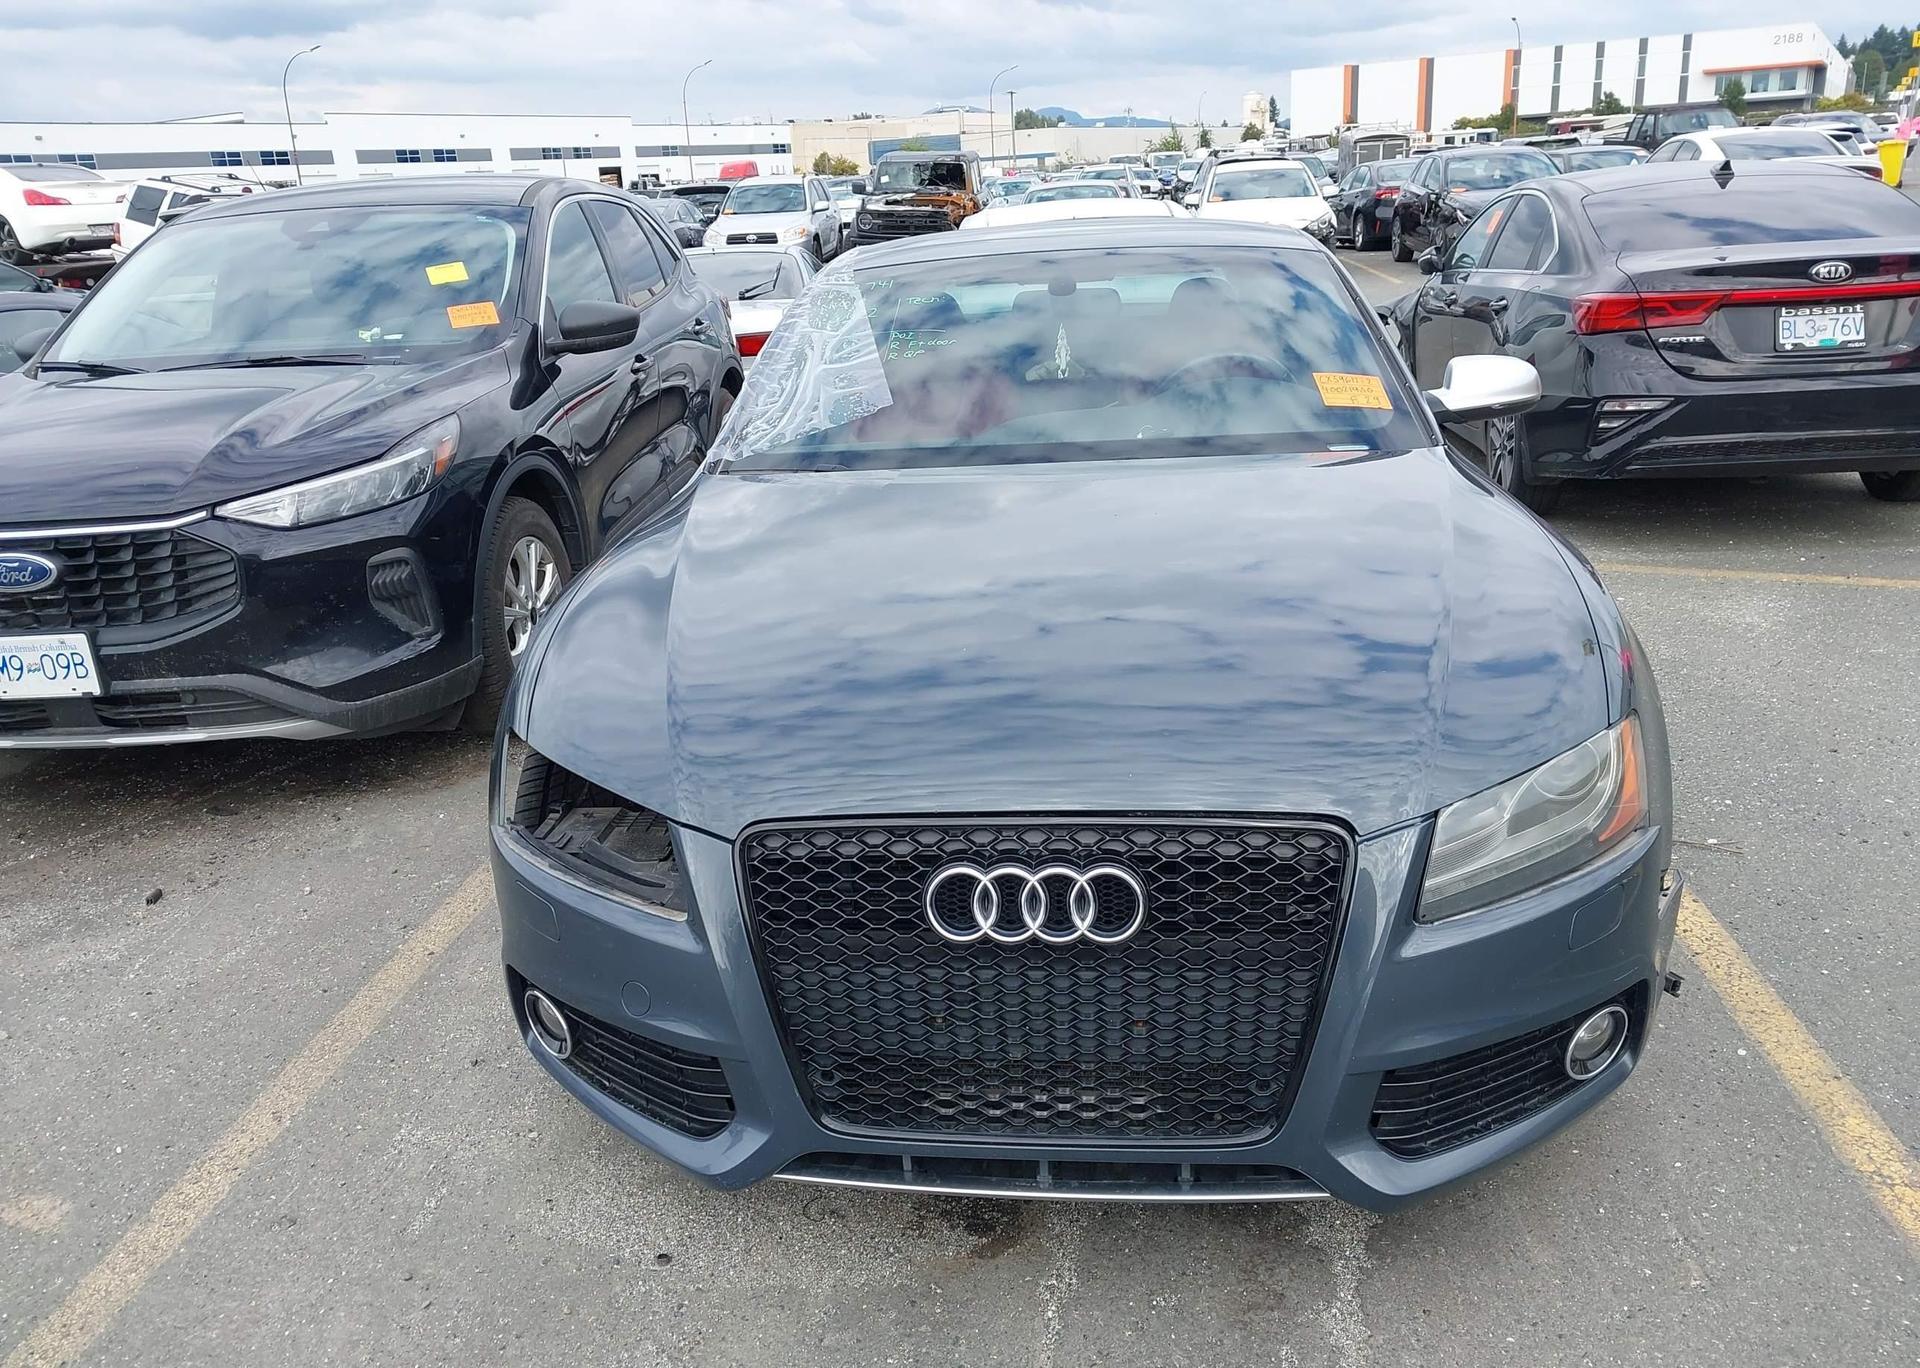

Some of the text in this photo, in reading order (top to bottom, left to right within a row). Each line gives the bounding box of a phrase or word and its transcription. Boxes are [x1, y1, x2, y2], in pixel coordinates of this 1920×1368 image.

[1774, 32, 1803, 45] 2188
[1819, 266, 1846, 278] KIA
[1781, 304, 1865, 316] basant
[1782, 316, 1864, 340] BL3 76V
[1658, 335, 1706, 344] FORTE
[40, 652, 89, 680] 09B
